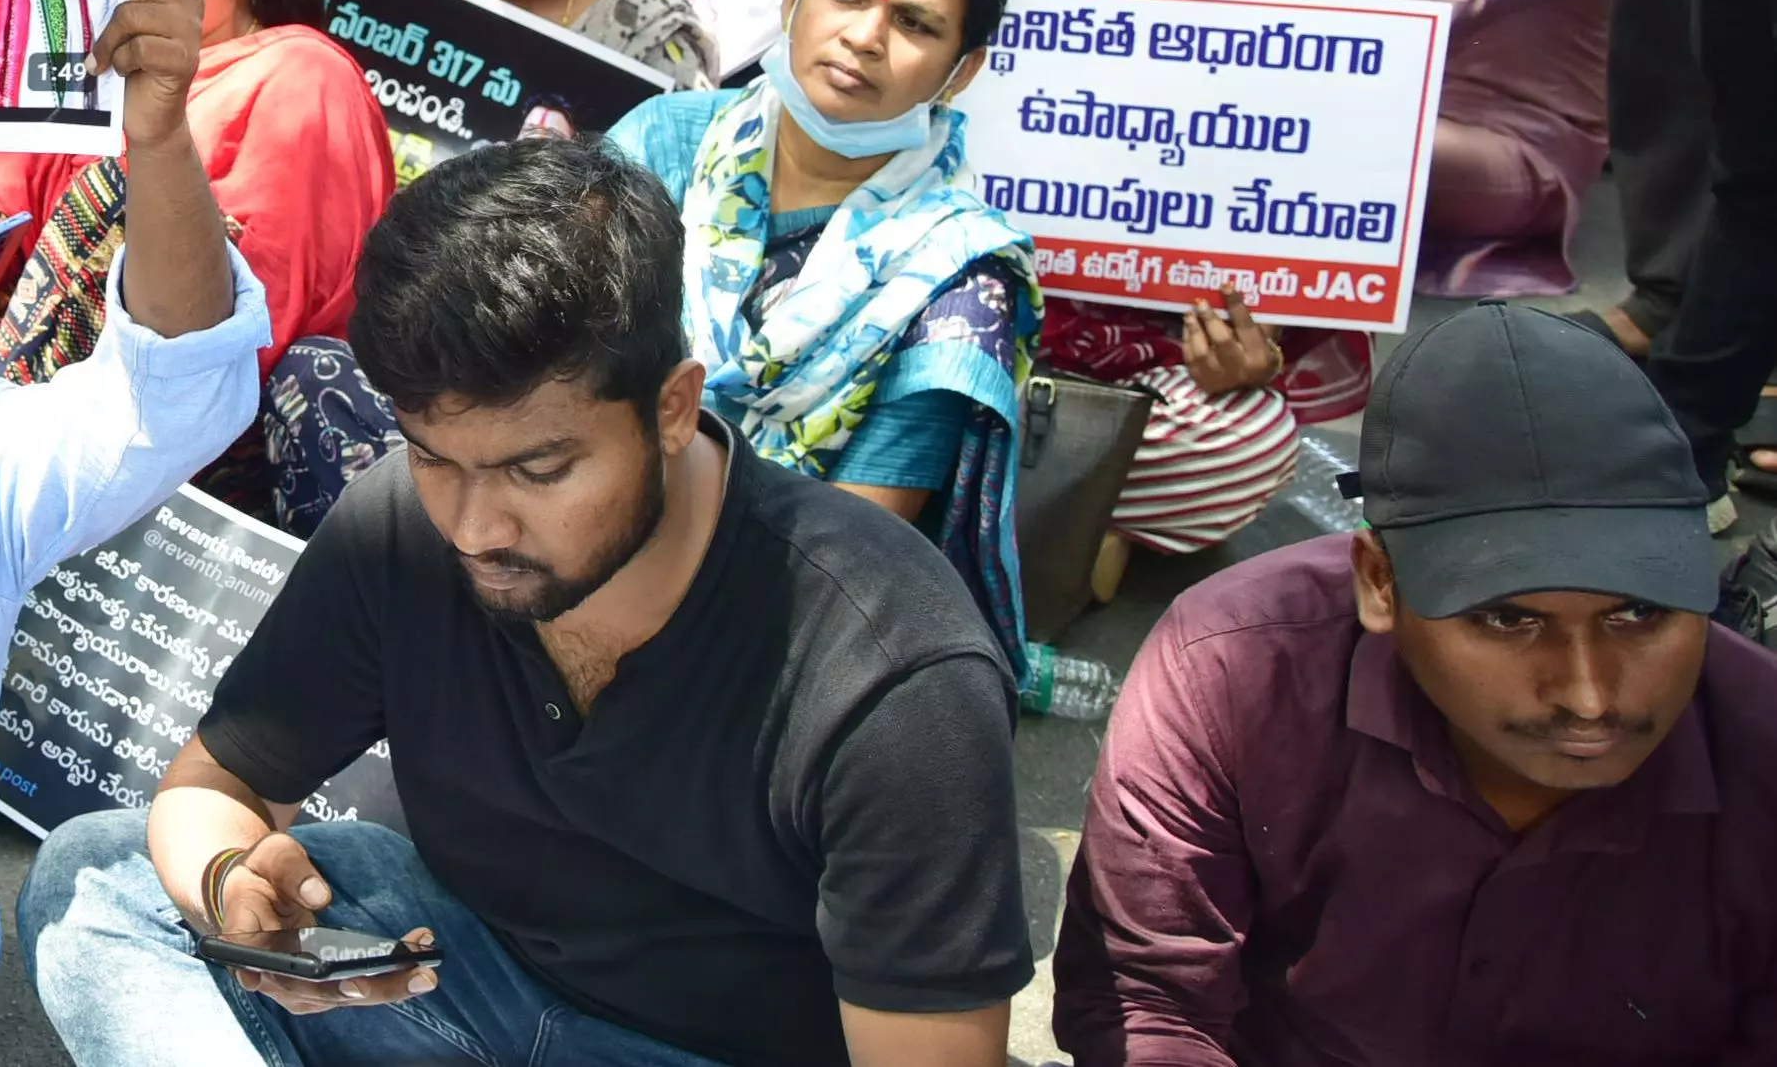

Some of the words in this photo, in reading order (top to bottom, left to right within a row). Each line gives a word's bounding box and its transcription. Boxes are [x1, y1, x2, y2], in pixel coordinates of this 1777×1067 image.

[37, 61, 87, 81] 1:49
[328, 1, 429, 67] నంబర్
[427, 40, 485, 88] 317
[481, 66, 522, 107] ను
[1148, 21, 1384, 76] ఆధారంగా
[1017, 87, 1311, 168] ఉపాధ్యాయుల
[982, 172, 1214, 236] ాయింపులు
[1226, 177, 1397, 244] చేయాలి
[1032, 247, 1077, 278] ధిత
[1083, 250, 1164, 294] ఉద్యోగ
[1302, 270, 1387, 305] JAC
[143, 529, 273, 606] @revanth_anum
[155, 506, 230, 562] Revanth
[228, 545, 285, 586] Reddy
[95, 549, 142, 581] జీవో
[135, 575, 219, 630] కారణంగా
[13, 629, 157, 727] రామర్శించడానికి
[131, 611, 211, 680] చేసుకున్న
[10, 672, 47, 705] గారి
[47, 697, 113, 748] కారును
[40, 738, 97, 787] అరెస్టు
